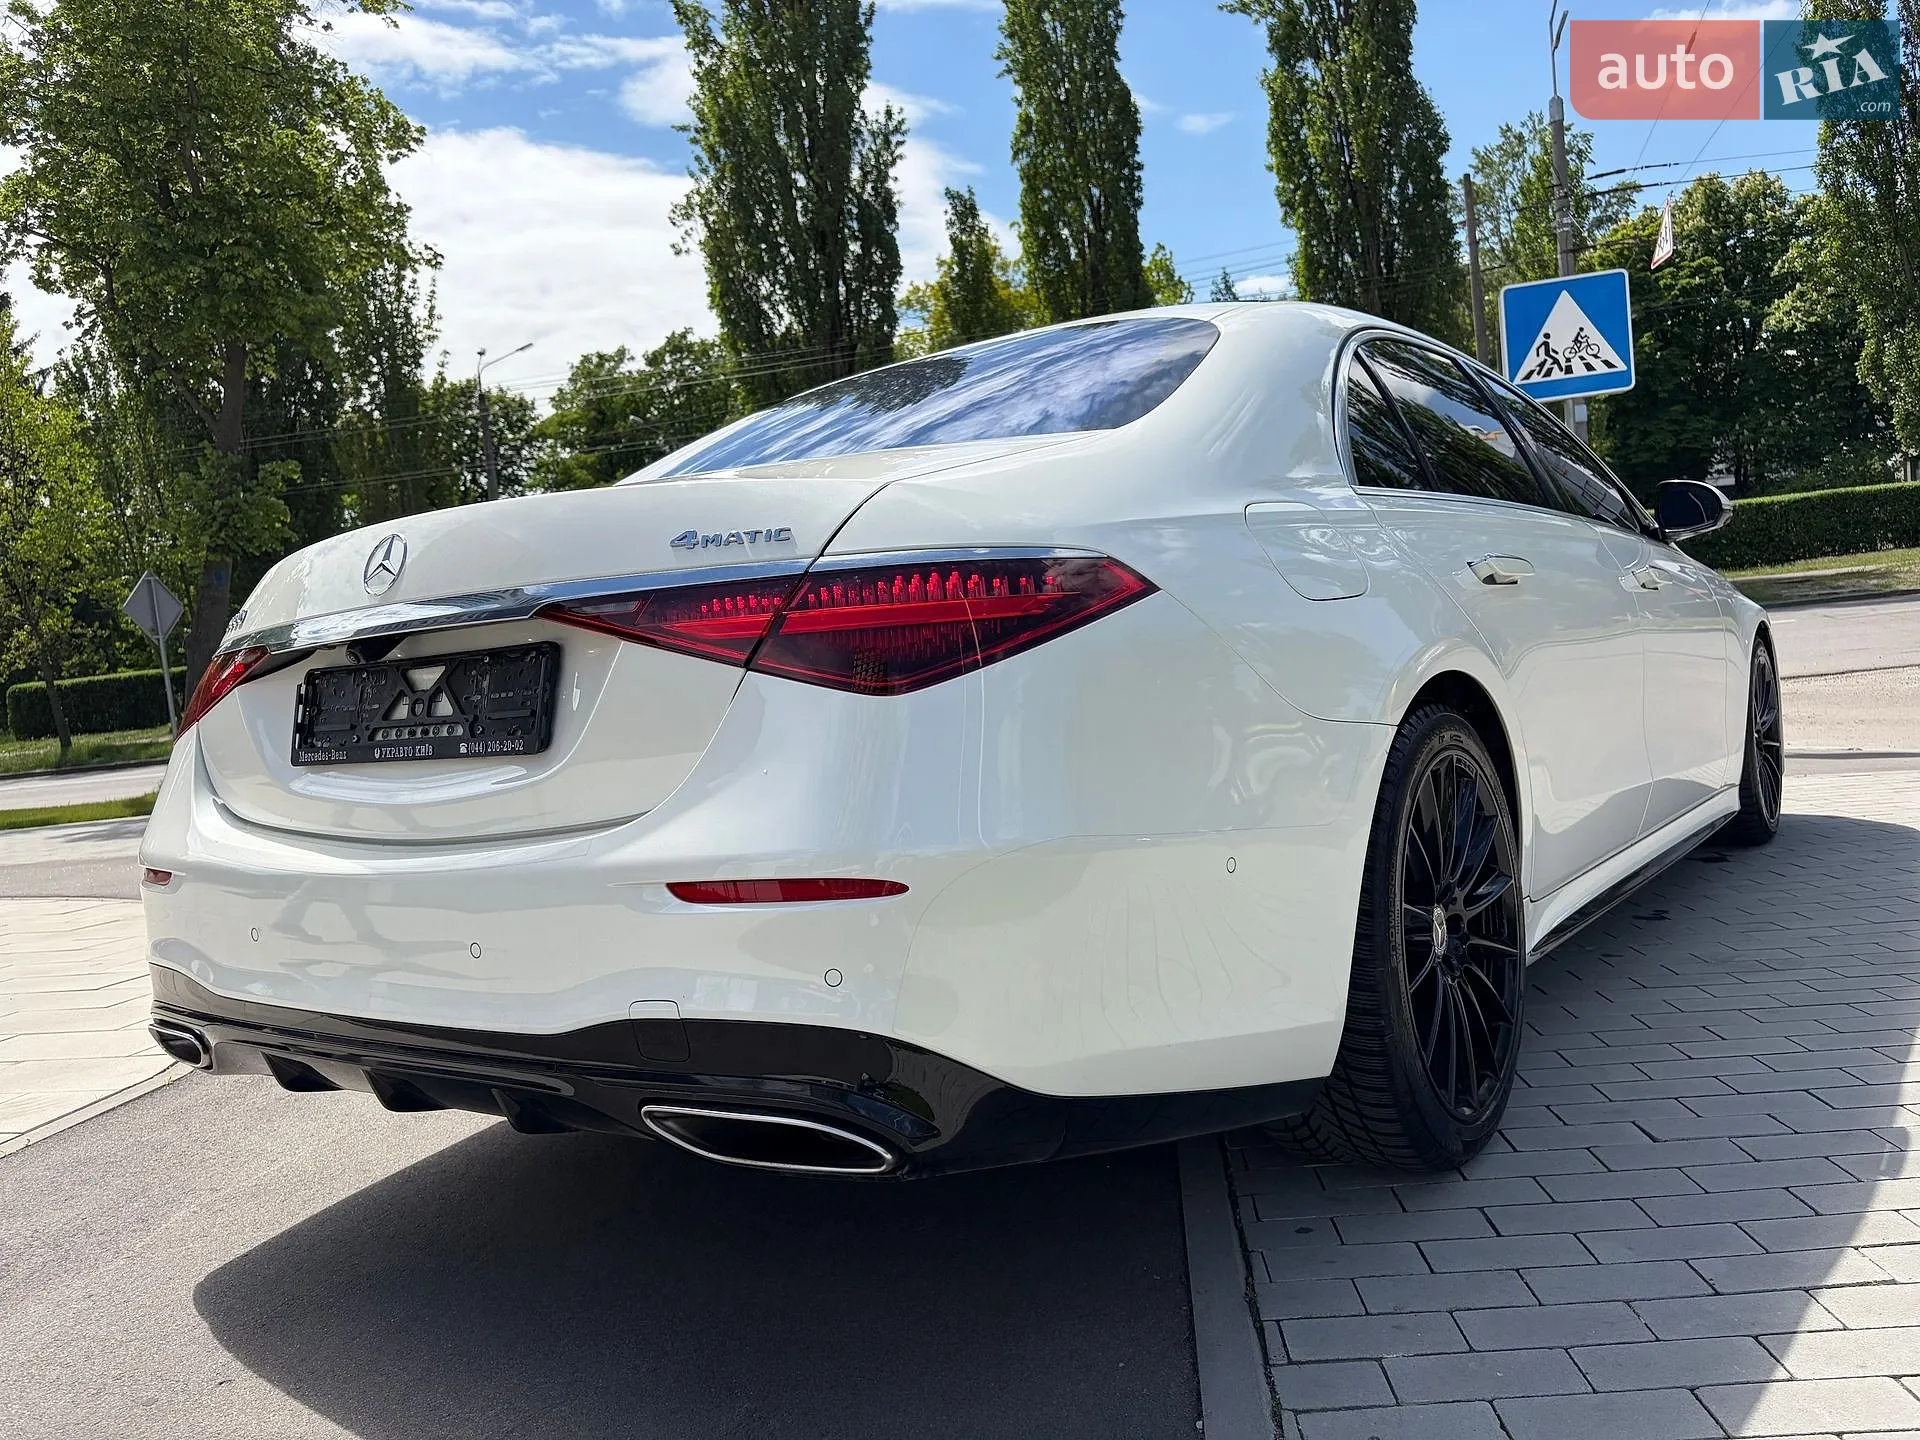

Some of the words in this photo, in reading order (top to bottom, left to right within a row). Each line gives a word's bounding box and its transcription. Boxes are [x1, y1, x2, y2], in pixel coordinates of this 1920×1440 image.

[669, 527, 791, 549] 4MATIC
[381, 747, 413, 758] УКРАВТО
[468, 741, 486, 755] (044)
[487, 740, 524, 752] 206-20-02
[299, 750, 347, 762] Mercedes-Benz
